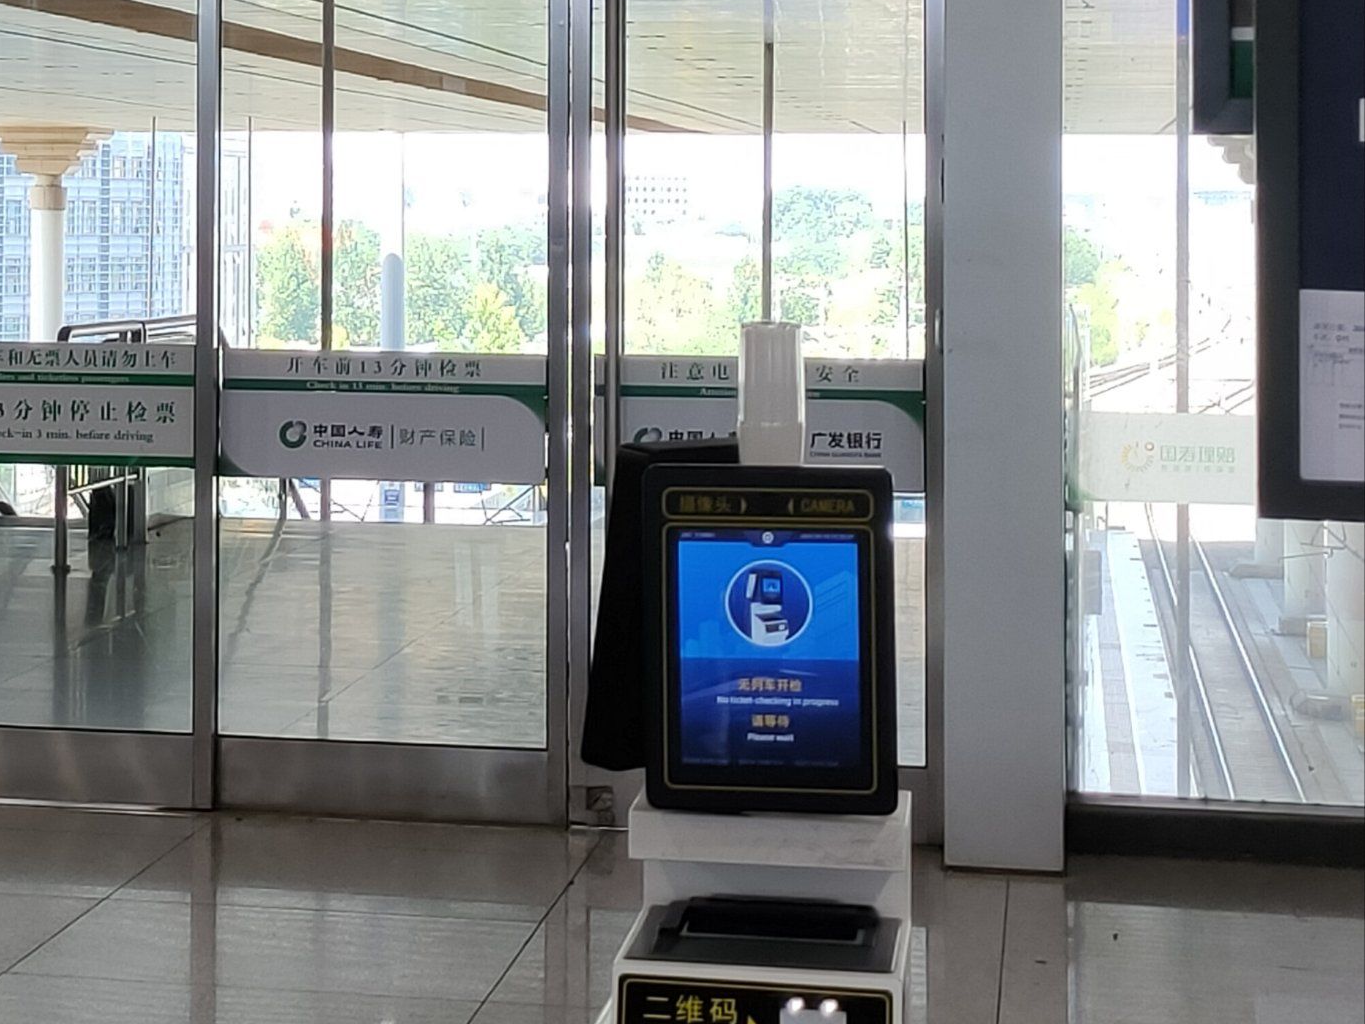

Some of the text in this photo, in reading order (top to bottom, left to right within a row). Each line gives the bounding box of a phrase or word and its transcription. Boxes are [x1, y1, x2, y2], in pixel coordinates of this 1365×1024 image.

[286, 355, 483, 378] 开车前13分钟检票
[75, 429, 110, 440] before
[113, 429, 154, 443] driving
[313, 423, 477, 447] 中国人寿 财产保险
[313, 439, 383, 449] CHINA LIFE
[809, 432, 882, 450] 广发银行
[800, 497, 856, 514] CAMERA
[642, 994, 738, 1024] 二维码
